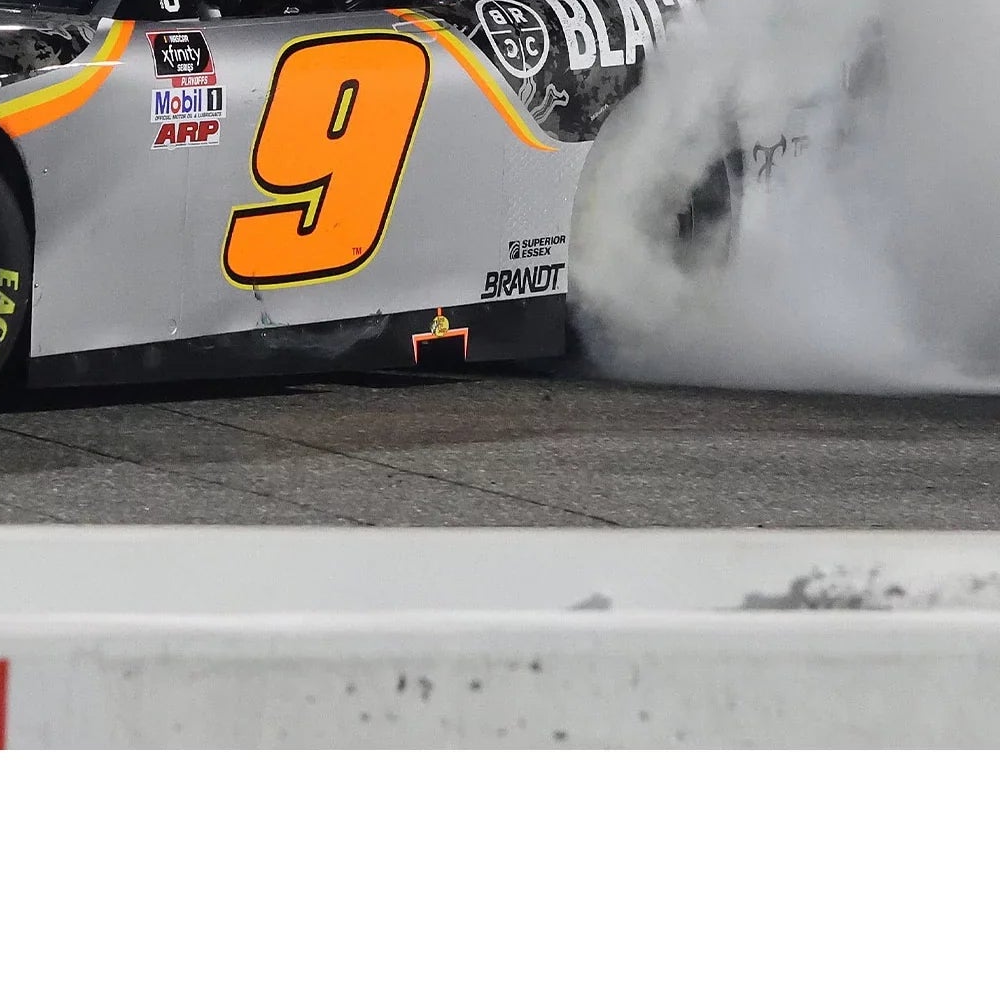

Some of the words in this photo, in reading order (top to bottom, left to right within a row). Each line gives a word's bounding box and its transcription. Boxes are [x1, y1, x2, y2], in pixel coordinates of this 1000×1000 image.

[169, 34, 190, 43] NASCAR
[161, 44, 201, 68] xfinity
[176, 63, 194, 73] SERIES
[180, 75, 208, 86] PLAYOFFS
[154, 88, 202, 115] Mobil
[154, 120, 219, 144] ARP
[221, 29, 432, 289] 9
[521, 234, 566, 249] SUPERIOR
[352, 247, 362, 256] TM
[521, 246, 552, 258] ESSEX
[480, 262, 566, 300] BRANDT
